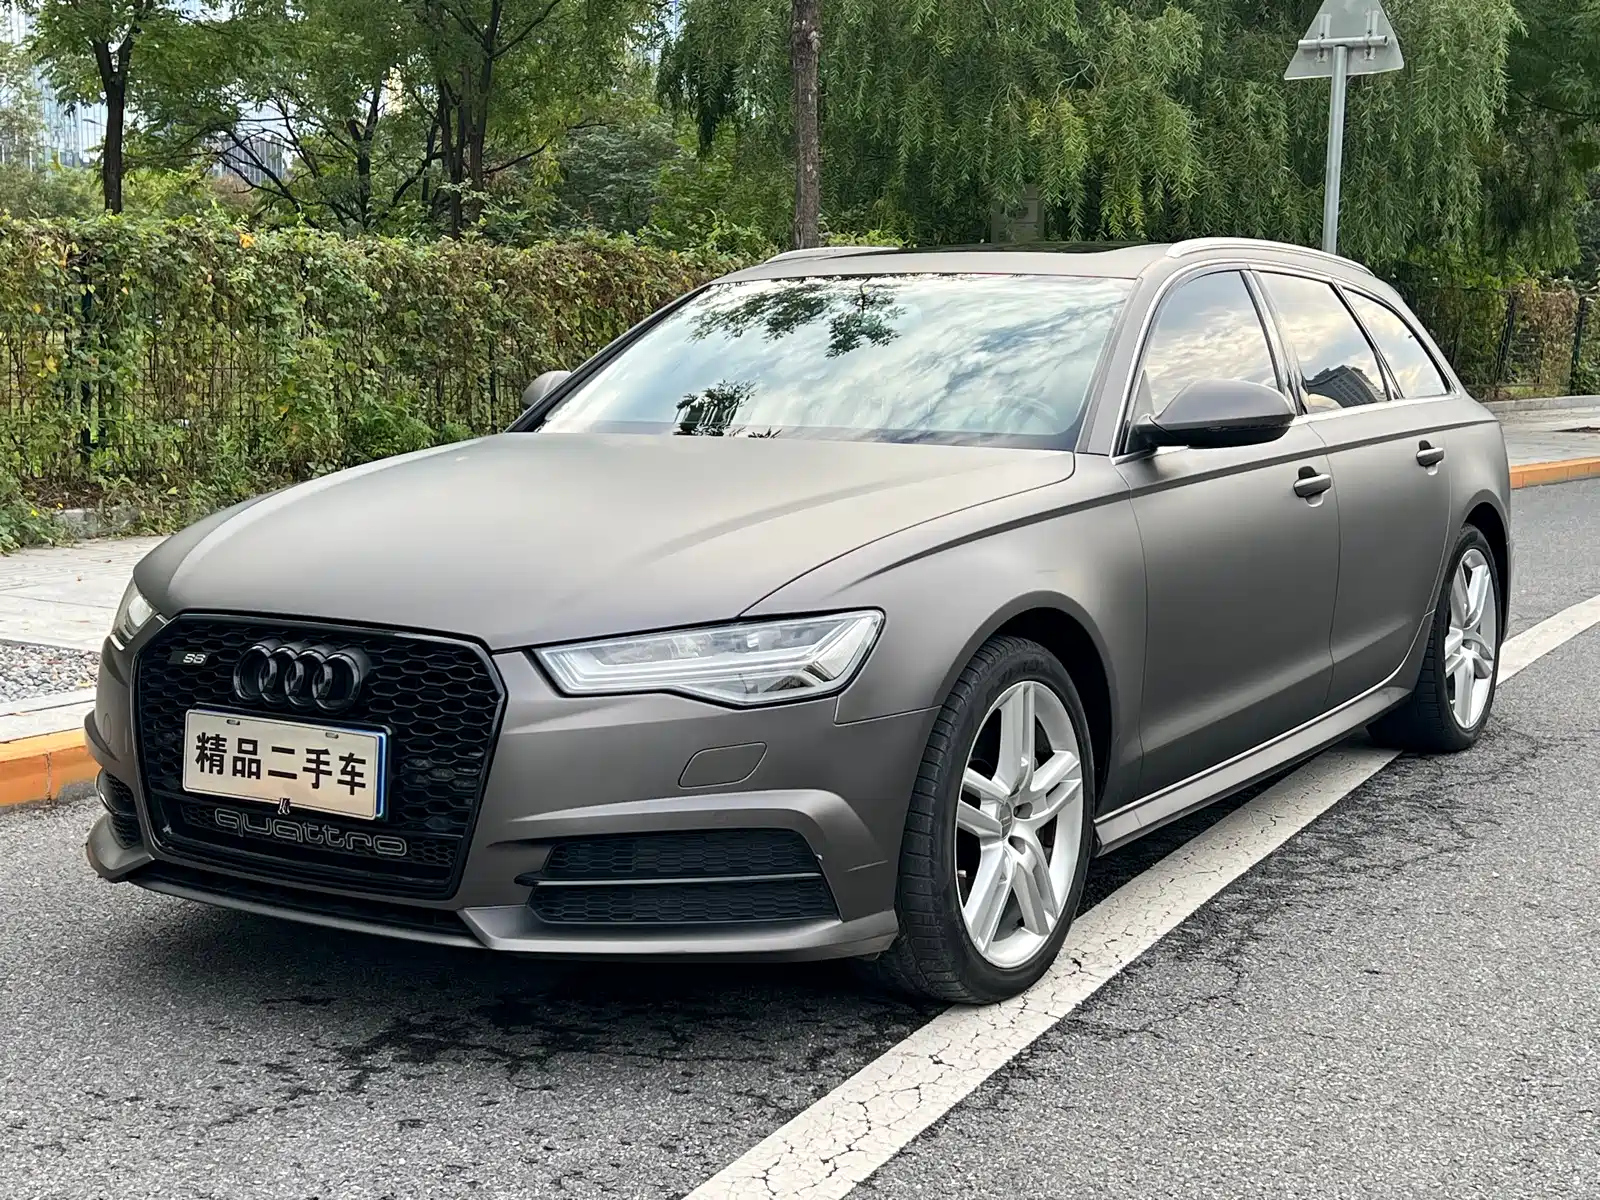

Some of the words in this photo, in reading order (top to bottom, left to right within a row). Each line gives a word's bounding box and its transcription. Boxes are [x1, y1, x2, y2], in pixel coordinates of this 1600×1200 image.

[195, 732, 367, 796] 精品二手车
[214, 808, 407, 856] quattro
